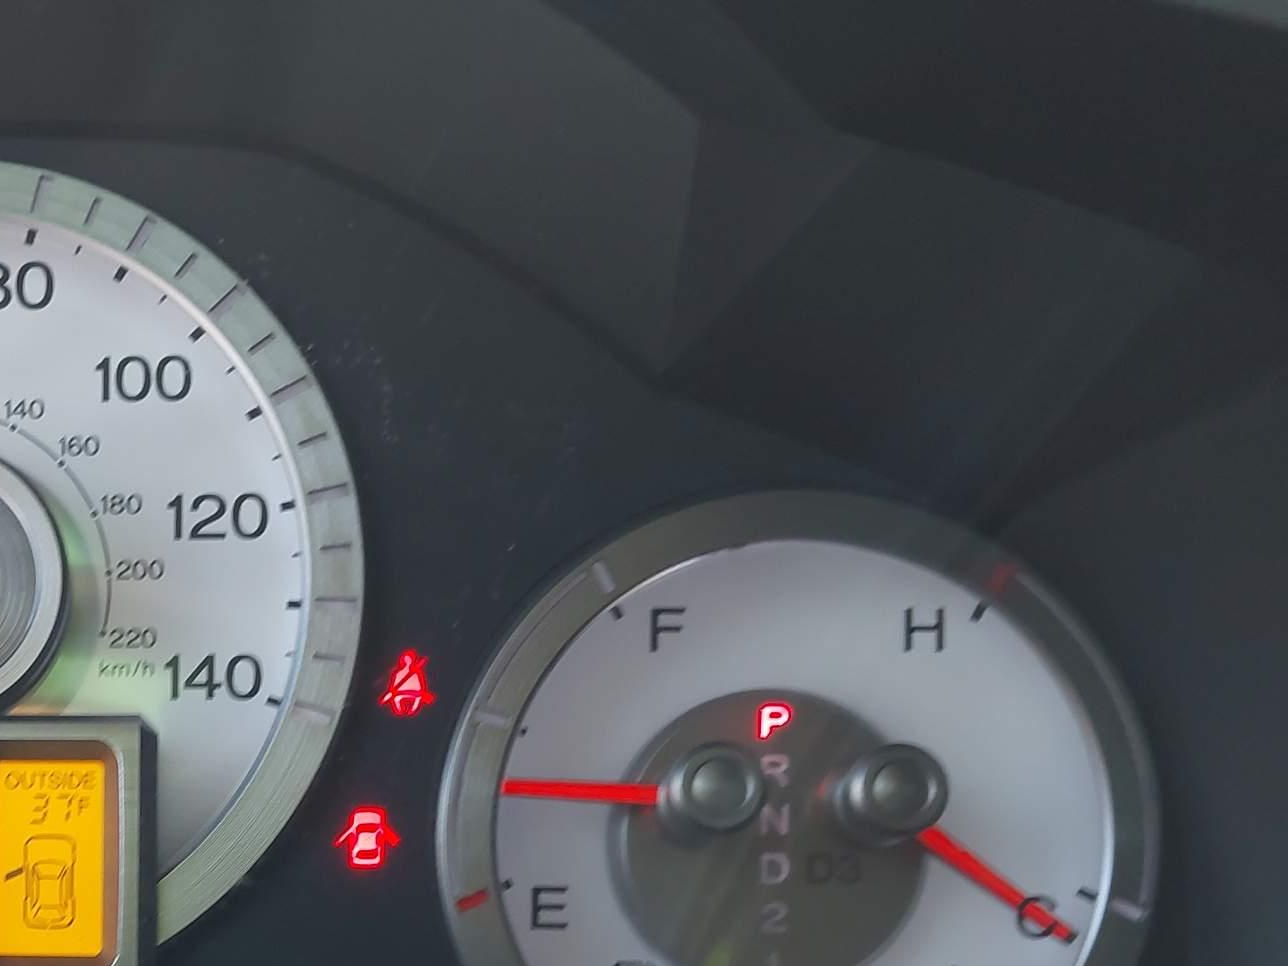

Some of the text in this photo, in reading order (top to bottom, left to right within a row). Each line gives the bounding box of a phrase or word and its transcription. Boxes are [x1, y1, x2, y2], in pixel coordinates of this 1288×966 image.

[98, 355, 193, 403] 100
[4, 399, 45, 421] 140
[59, 435, 100, 459] 160
[101, 493, 143, 516] 180
[168, 493, 269, 542] 120
[116, 558, 165, 582] 200
[110, 627, 157, 650] 220
[649, 607, 686, 653] F
[903, 607, 946, 653] H
[98, 658, 155, 678] km/h
[165, 654, 263, 701] 140
[757, 704, 791, 739] P
[4, 770, 96, 791] OUTSIDE
[760, 753, 790, 788] R
[760, 802, 790, 835] N
[760, 852, 791, 884] D
[530, 886, 569, 930] E
[761, 902, 788, 933] 2
[1015, 894, 1057, 938] C
